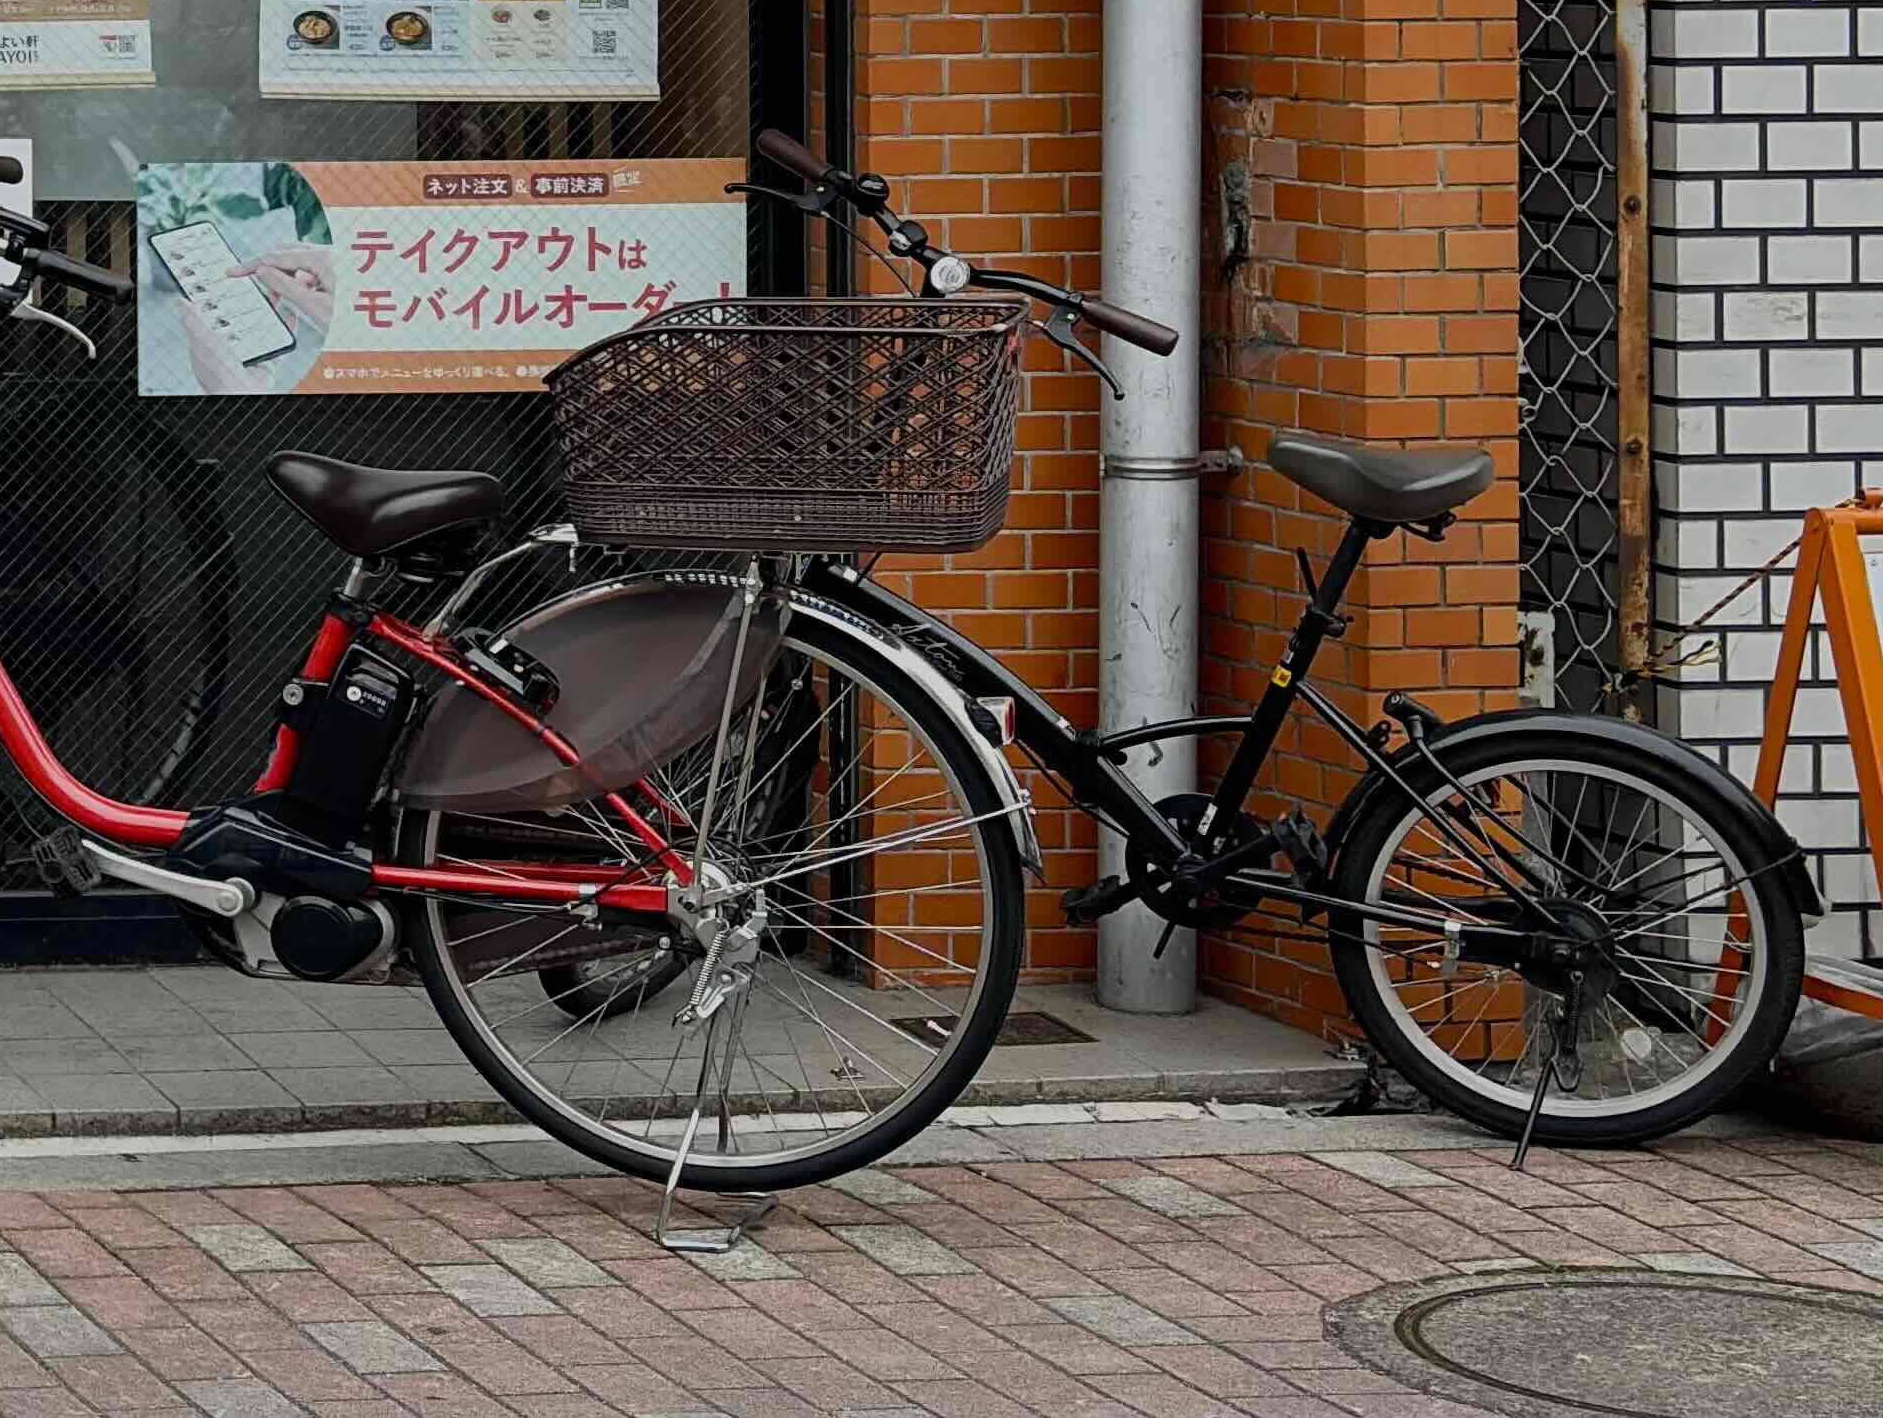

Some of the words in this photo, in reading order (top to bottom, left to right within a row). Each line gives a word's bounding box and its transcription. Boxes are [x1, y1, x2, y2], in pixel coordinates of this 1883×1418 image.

[427, 178, 508, 195] ネット注文
[514, 180, 529, 194] &
[535, 177, 604, 194] 事前決済
[350, 225, 647, 274] テイクアウトは
[354, 281, 730, 331] モバイルオーダ
